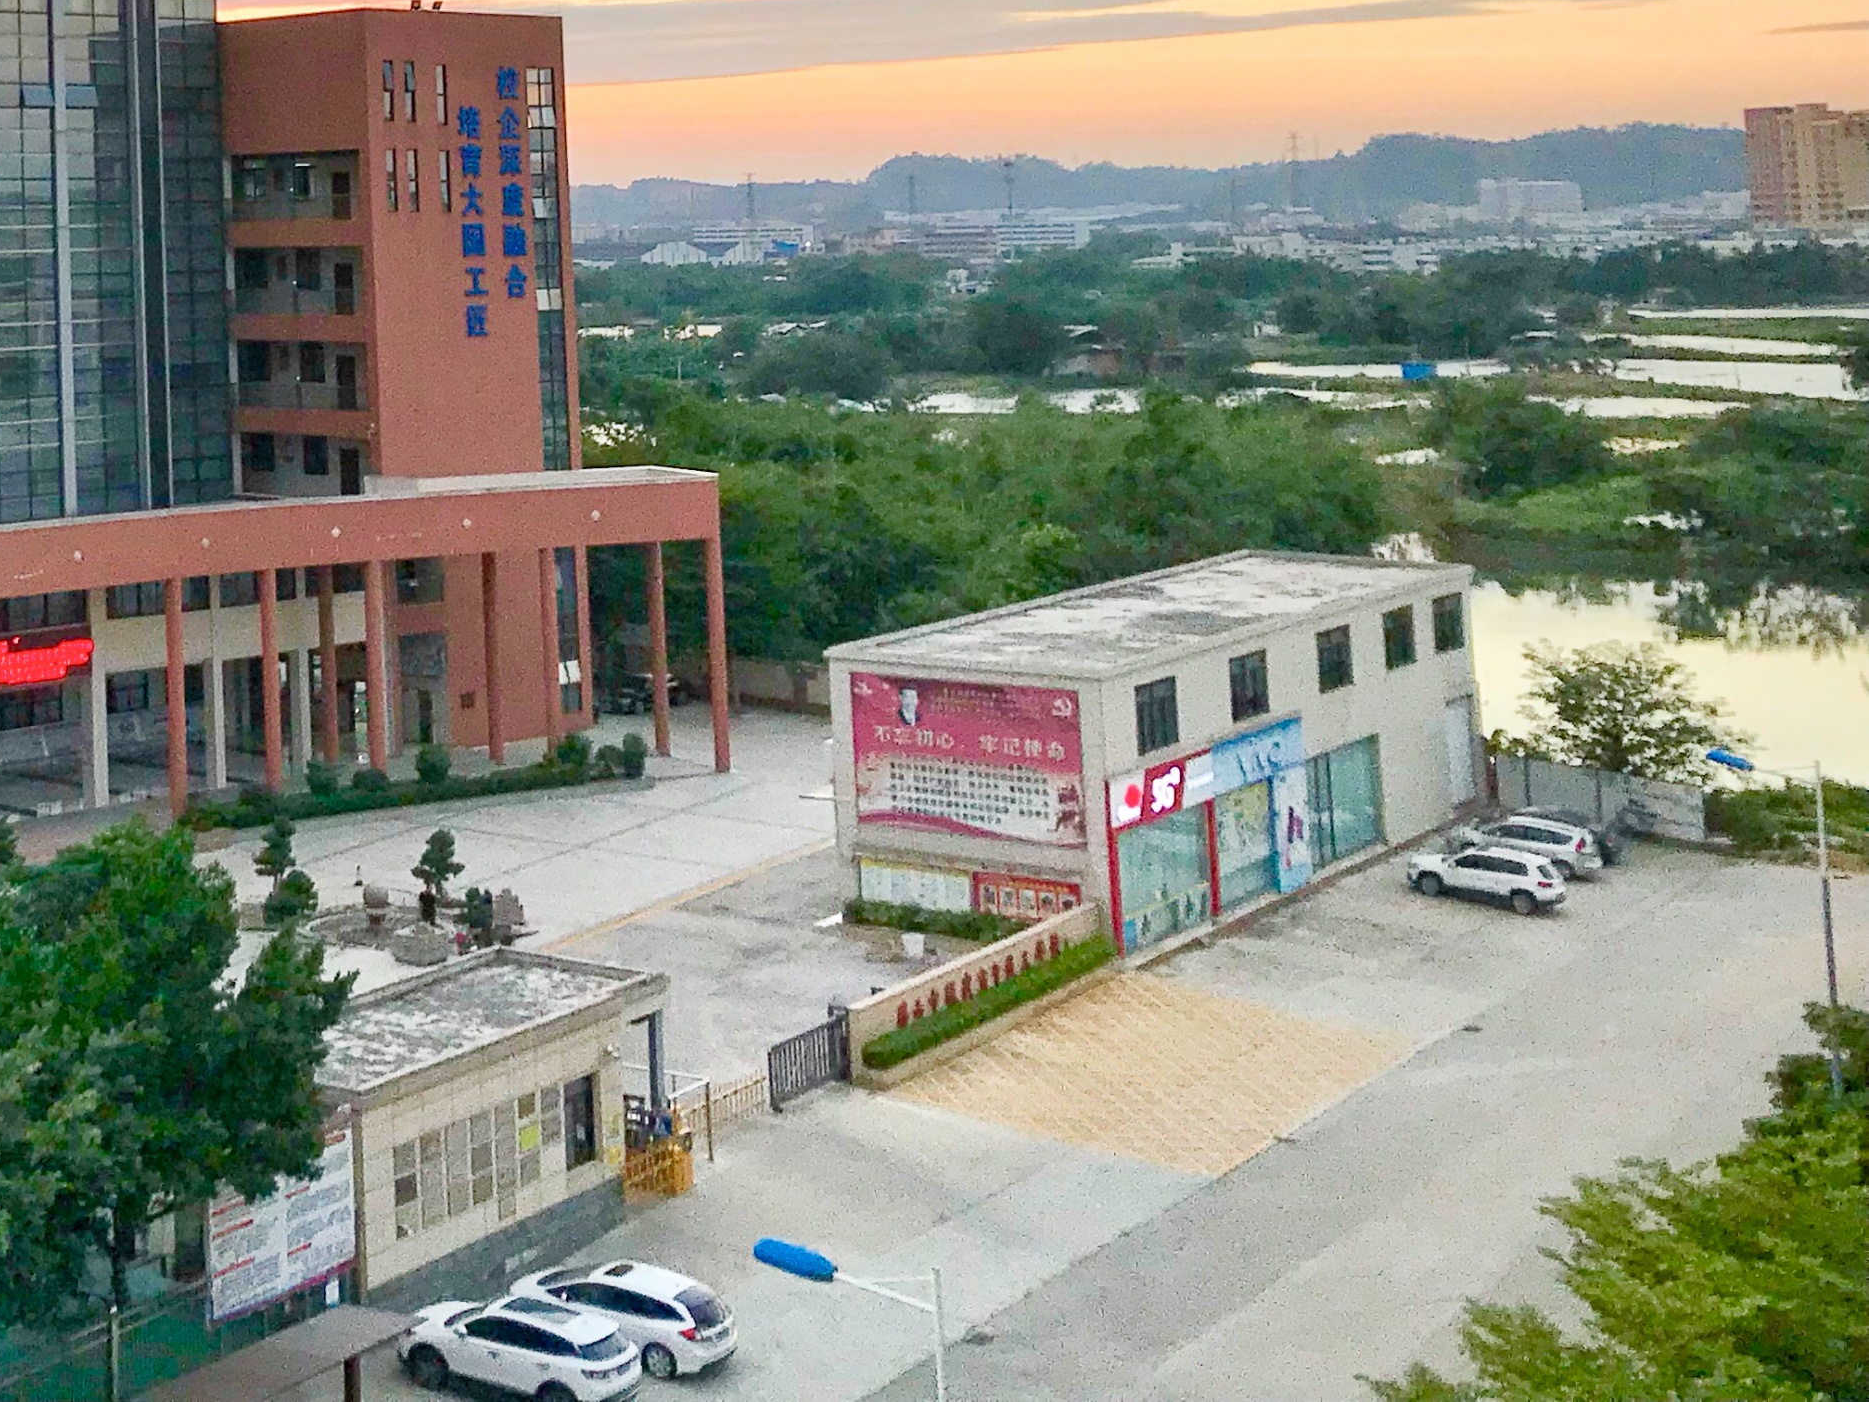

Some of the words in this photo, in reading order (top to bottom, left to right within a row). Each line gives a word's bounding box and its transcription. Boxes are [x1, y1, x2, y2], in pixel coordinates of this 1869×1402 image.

[457, 106, 489, 337] 培育大国工匠
[495, 65, 528, 298] 校企深度融合
